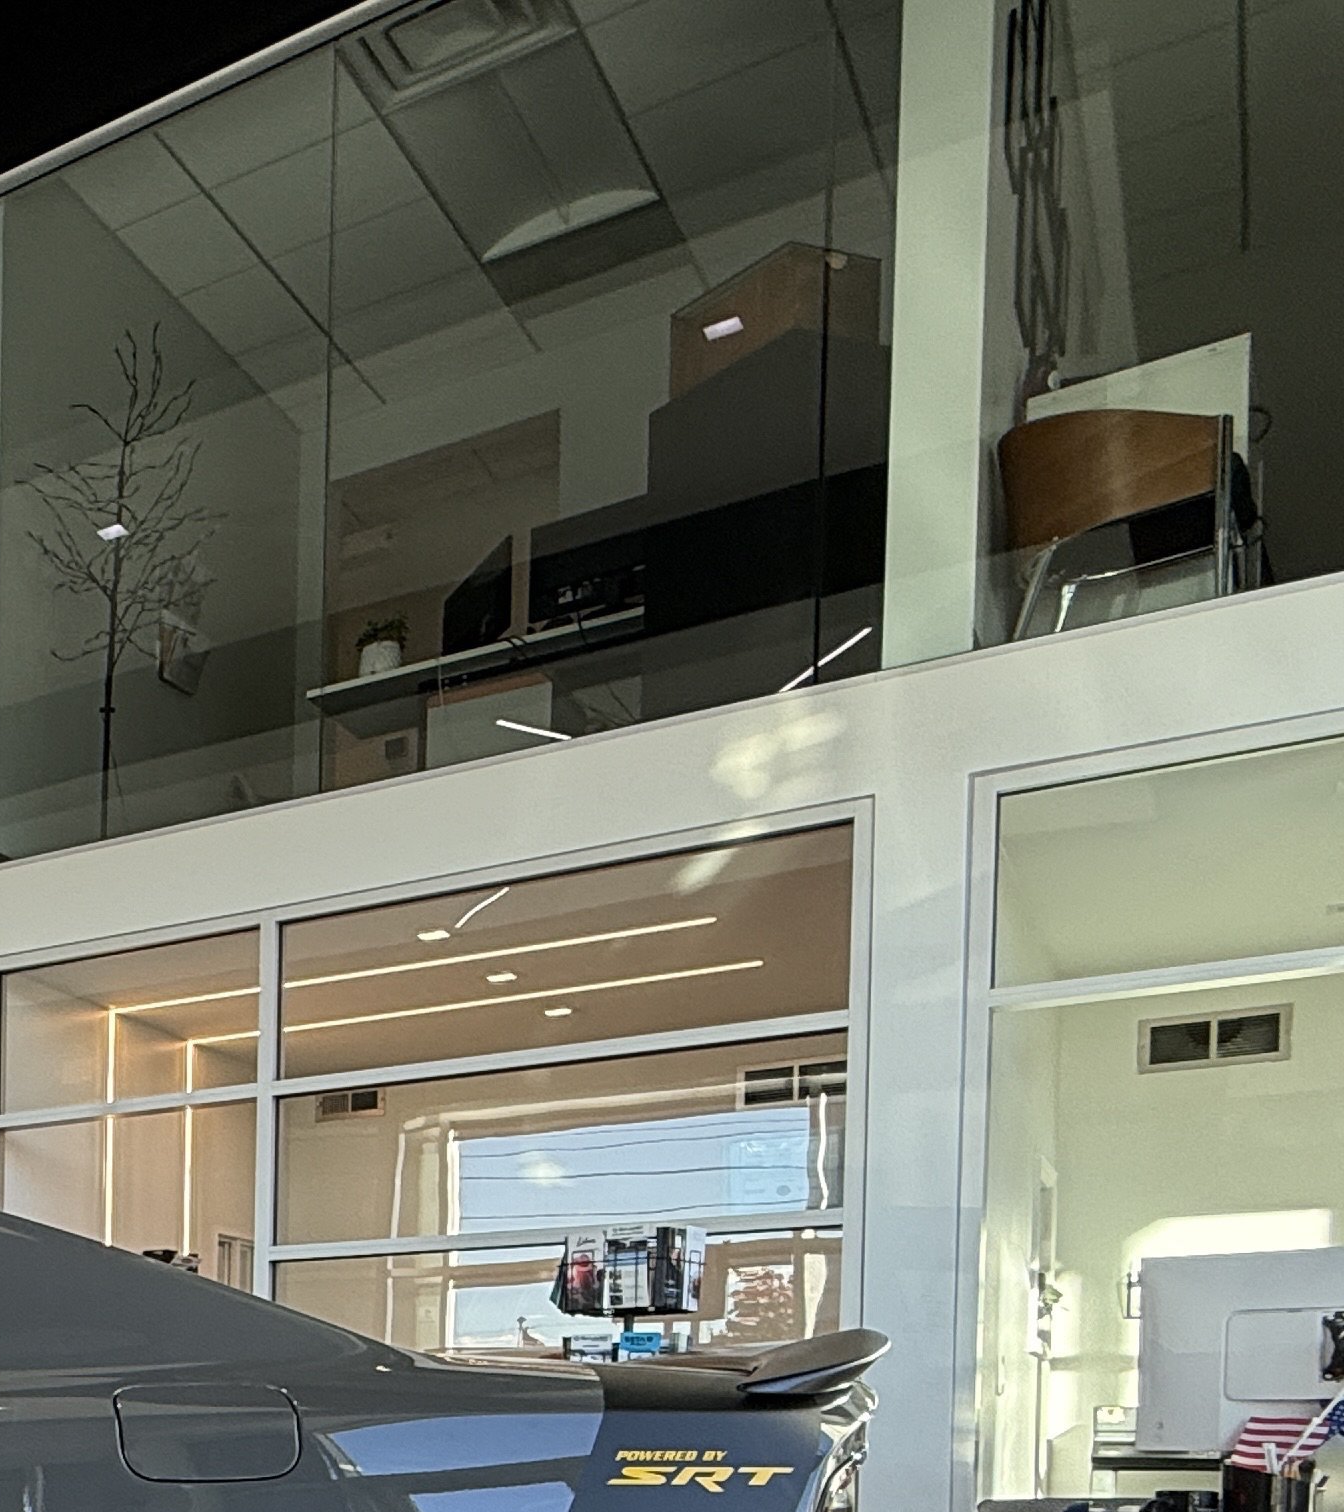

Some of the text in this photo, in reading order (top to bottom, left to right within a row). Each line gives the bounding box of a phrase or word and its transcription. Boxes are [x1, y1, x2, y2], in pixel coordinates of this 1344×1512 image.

[615, 1450, 727, 1462] POWERED BY
[606, 1466, 795, 1493] SRT
